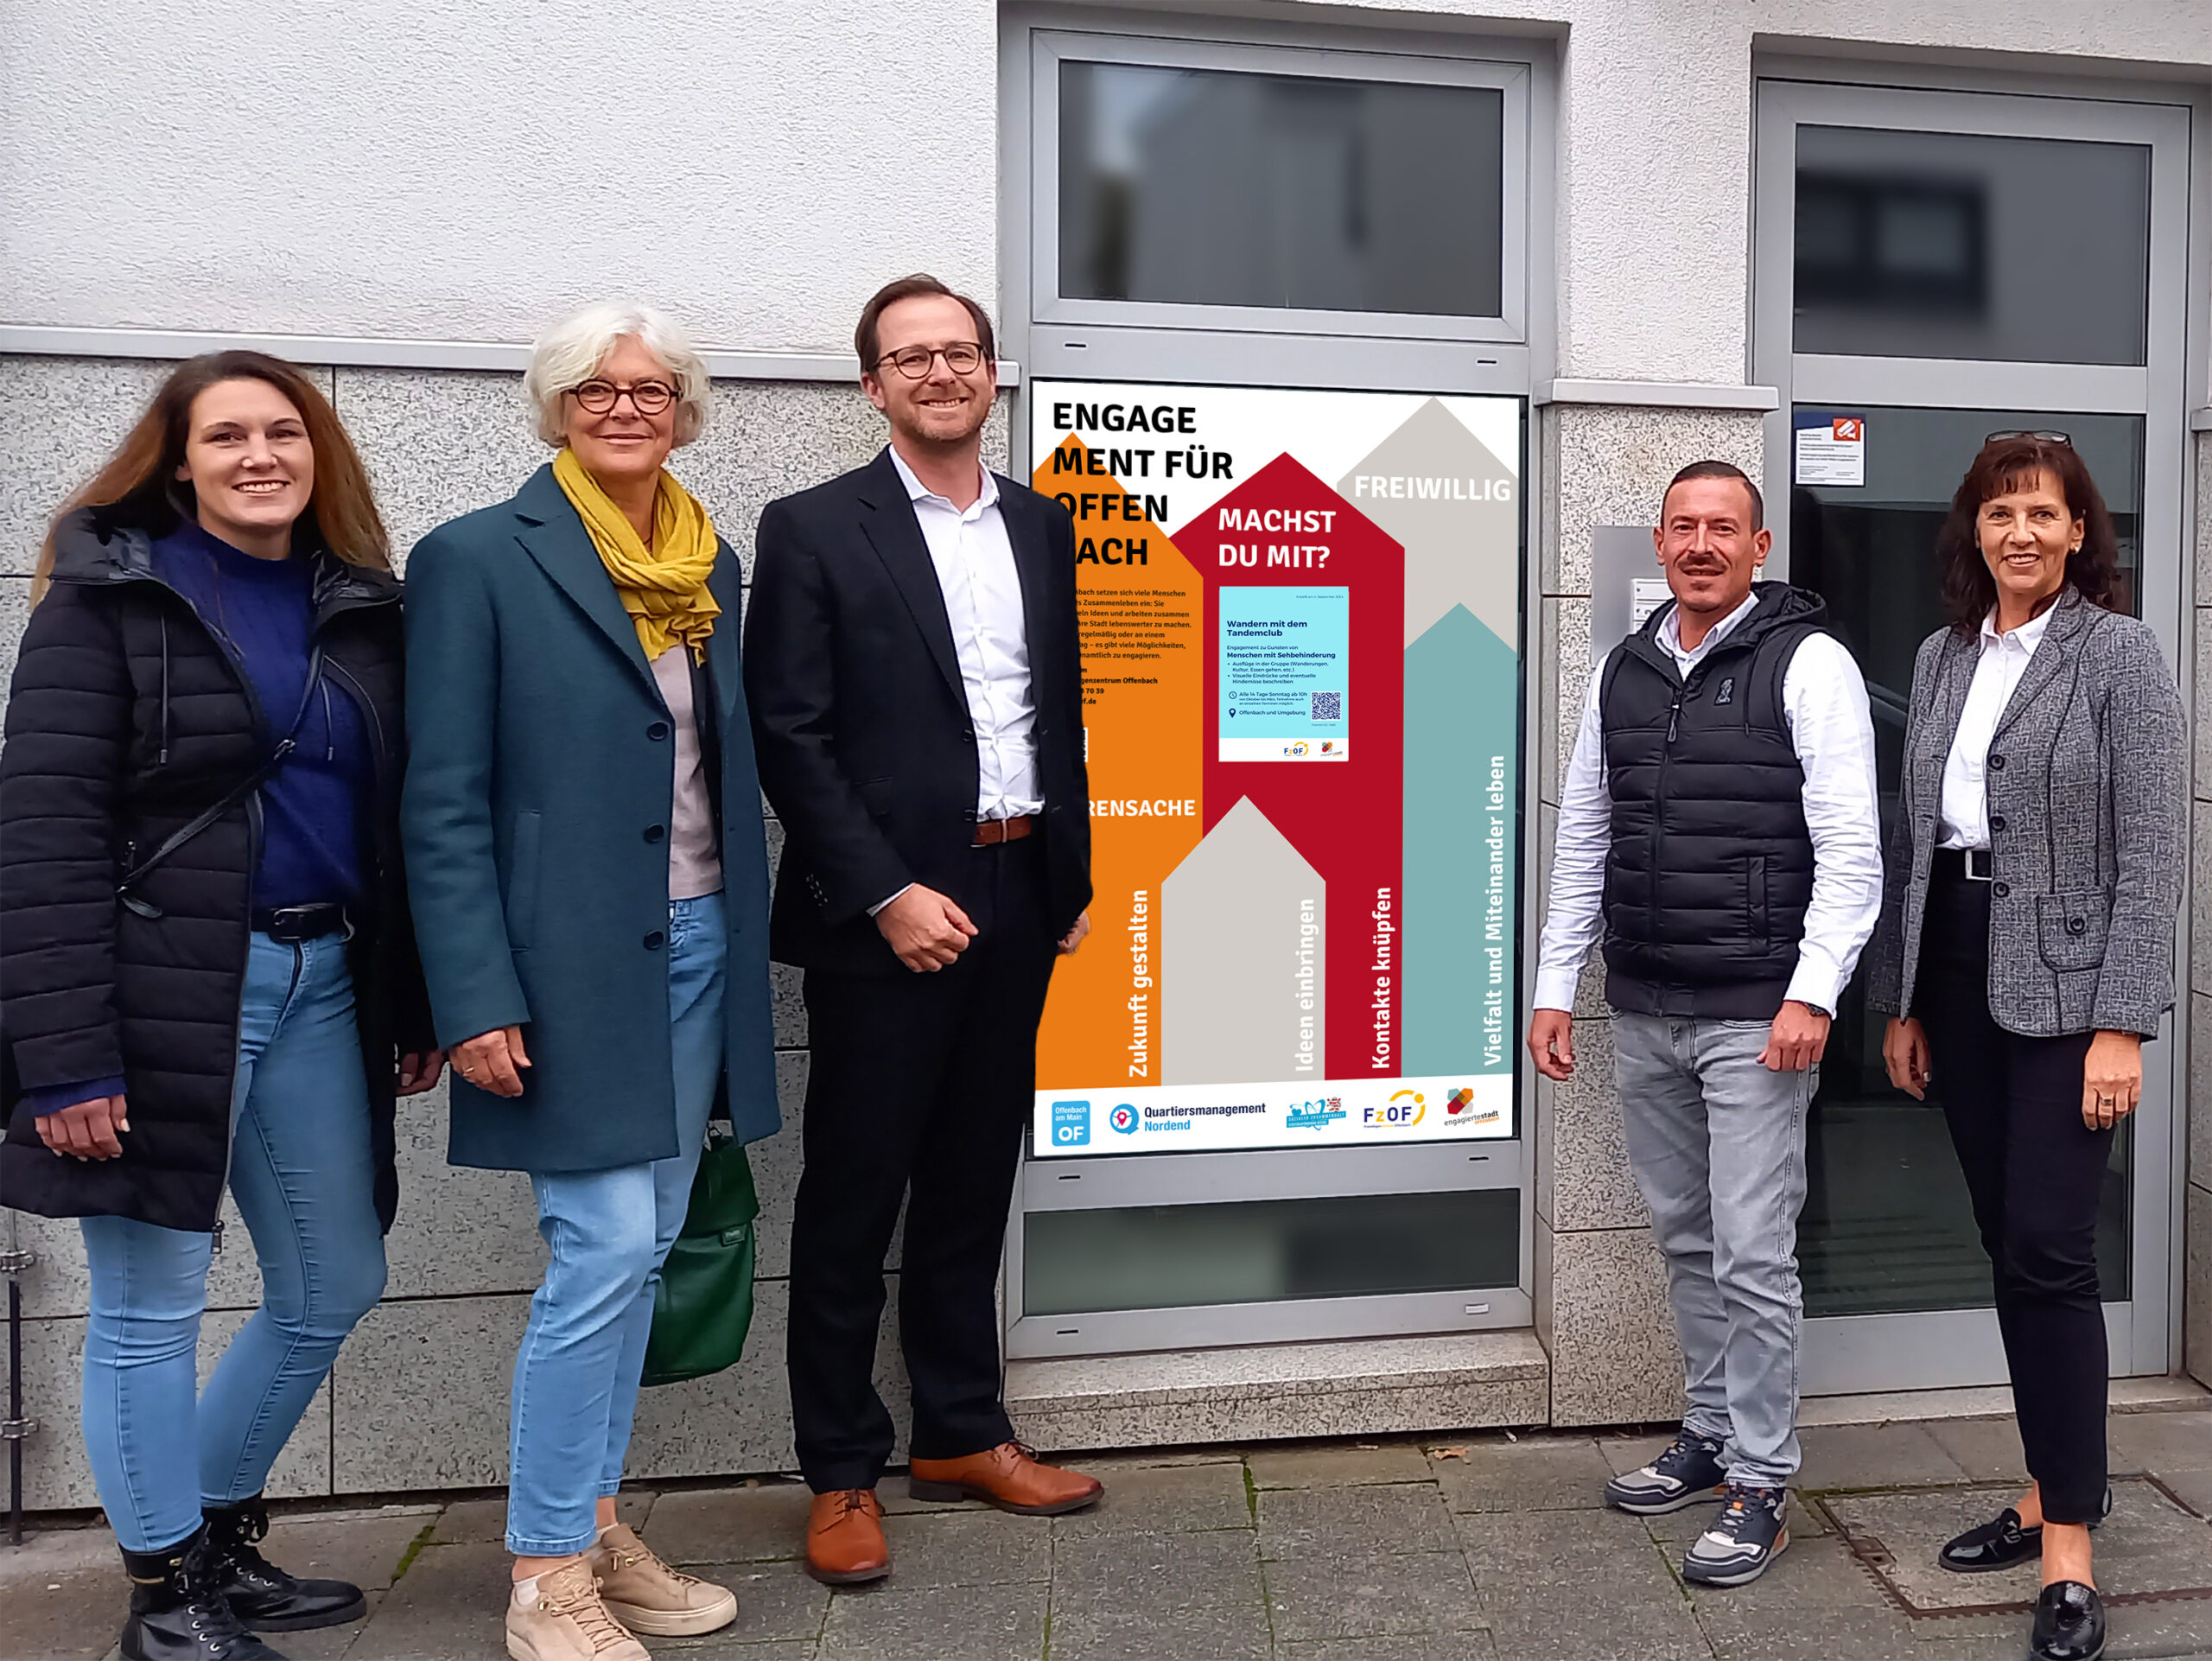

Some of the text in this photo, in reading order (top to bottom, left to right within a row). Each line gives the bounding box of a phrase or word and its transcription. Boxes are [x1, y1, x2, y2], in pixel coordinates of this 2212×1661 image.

[1052, 402, 1198, 434] ENGAGE
[1052, 443, 1234, 480] MENT FÜR
[1354, 474, 1512, 502] FREIWILLIG
[1217, 507, 1337, 534] MACHST
[1076, 537, 1148, 566] ACH
[1217, 544, 1331, 570] DU MIT?
[1119, 588, 1134, 596] sich
[1104, 640, 1118, 649] gibt
[1136, 640, 1186, 649] Möglichkeiten,
[1088, 799, 1197, 817] RENSACHE
[1484, 754, 1505, 1067] Vielfalt und Miteinander leben
[1128, 889, 1154, 1078] Zukunft gestalten
[1294, 898, 1320, 1072] Ideen einbringen
[1371, 887, 1396, 1069] Kontakte knüpfen
[1054, 1106, 1088, 1116] Offenbach
[1066, 1113, 1083, 1122] Main
[1144, 1103, 1267, 1118] Quartiersmanagement
[1363, 1105, 1413, 1123] FzOF
[1058, 1125, 1085, 1142] OF
[1144, 1119, 1192, 1132] Nordend
